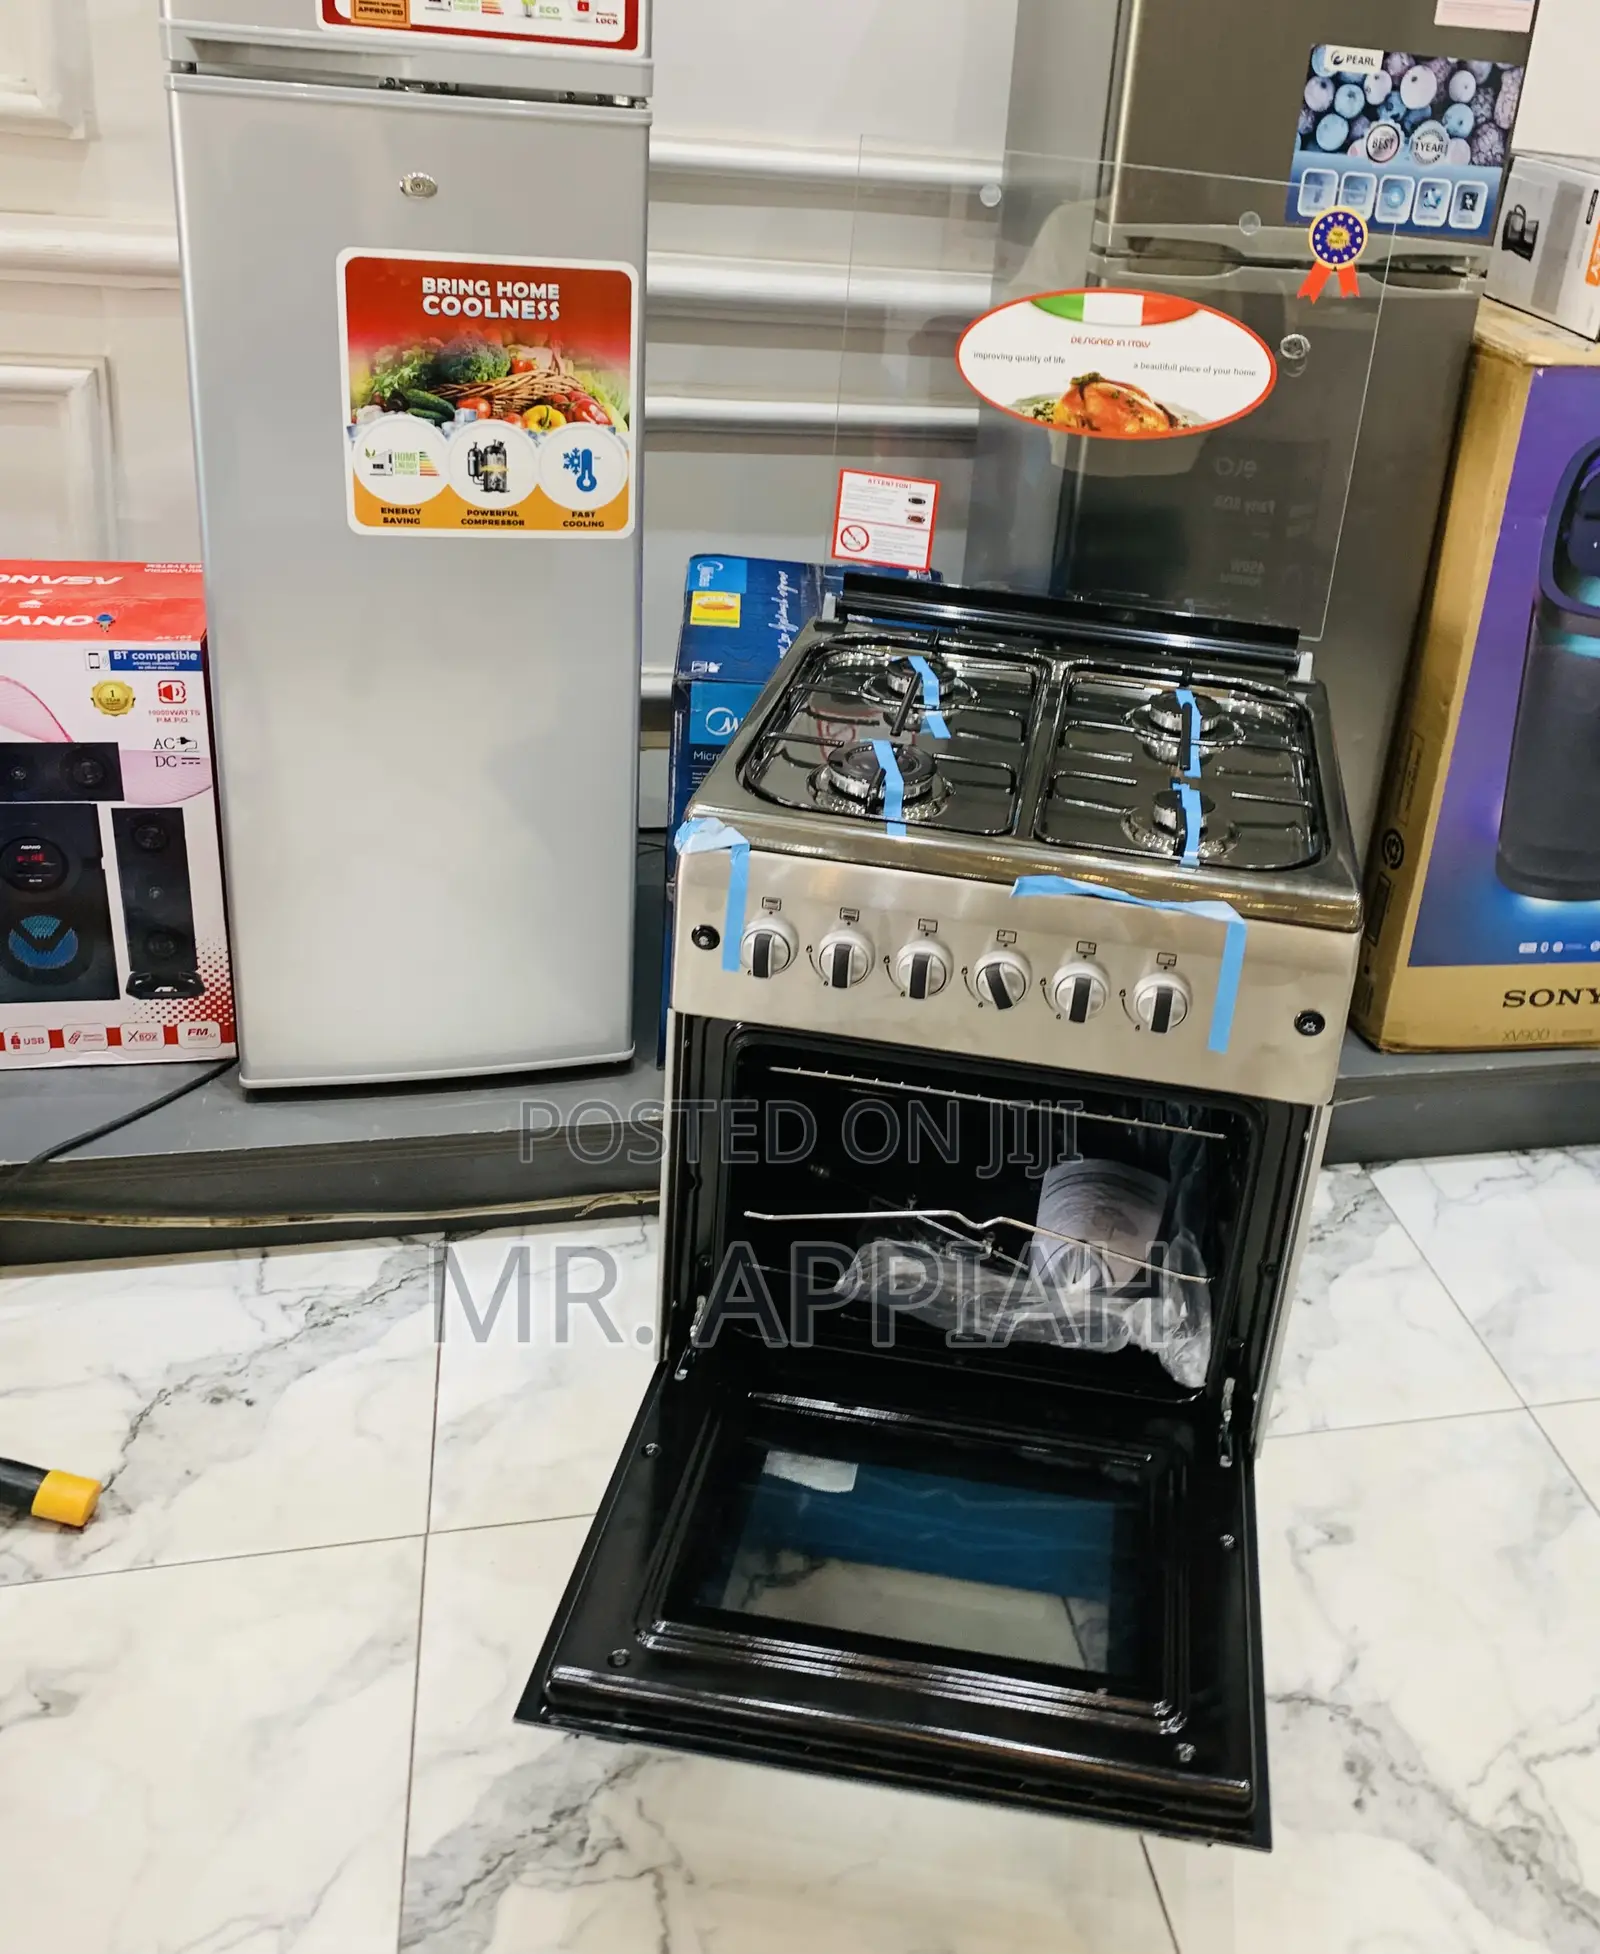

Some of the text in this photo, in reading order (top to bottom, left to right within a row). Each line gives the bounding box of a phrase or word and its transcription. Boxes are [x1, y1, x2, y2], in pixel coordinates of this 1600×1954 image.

[358, 6, 404, 16] APPROVED
[539, 5, 560, 14] ECO
[595, 17, 618, 25] LOCK
[1345, 54, 1376, 67] PEARL
[422, 276, 560, 300] BRING HOME
[422, 294, 561, 321] COOLNESS
[1070, 336, 1114, 347] DESIGNED
[973, 351, 1066, 364] improving quality of life
[1179, 365, 1201, 374] piece
[1203, 365, 1212, 374] of
[1213, 368, 1231, 377] your
[1233, 368, 1257, 377] home
[867, 477, 913, 490] ATTENTION!
[380, 507, 422, 515] ENERGY
[466, 509, 519, 518] POWERFUL
[571, 511, 596, 519] FAST
[382, 517, 421, 525] SAVING
[460, 518, 525, 527] COMPRESSOR
[562, 520, 605, 528] COOLING
[113, 650, 198, 662] BT compatible
[110, 689, 116, 698] 1
[153, 738, 176, 750] AC
[155, 756, 177, 768] DC
[1502, 986, 1600, 1008] SONY
[187, 1028, 208, 1036] FM
